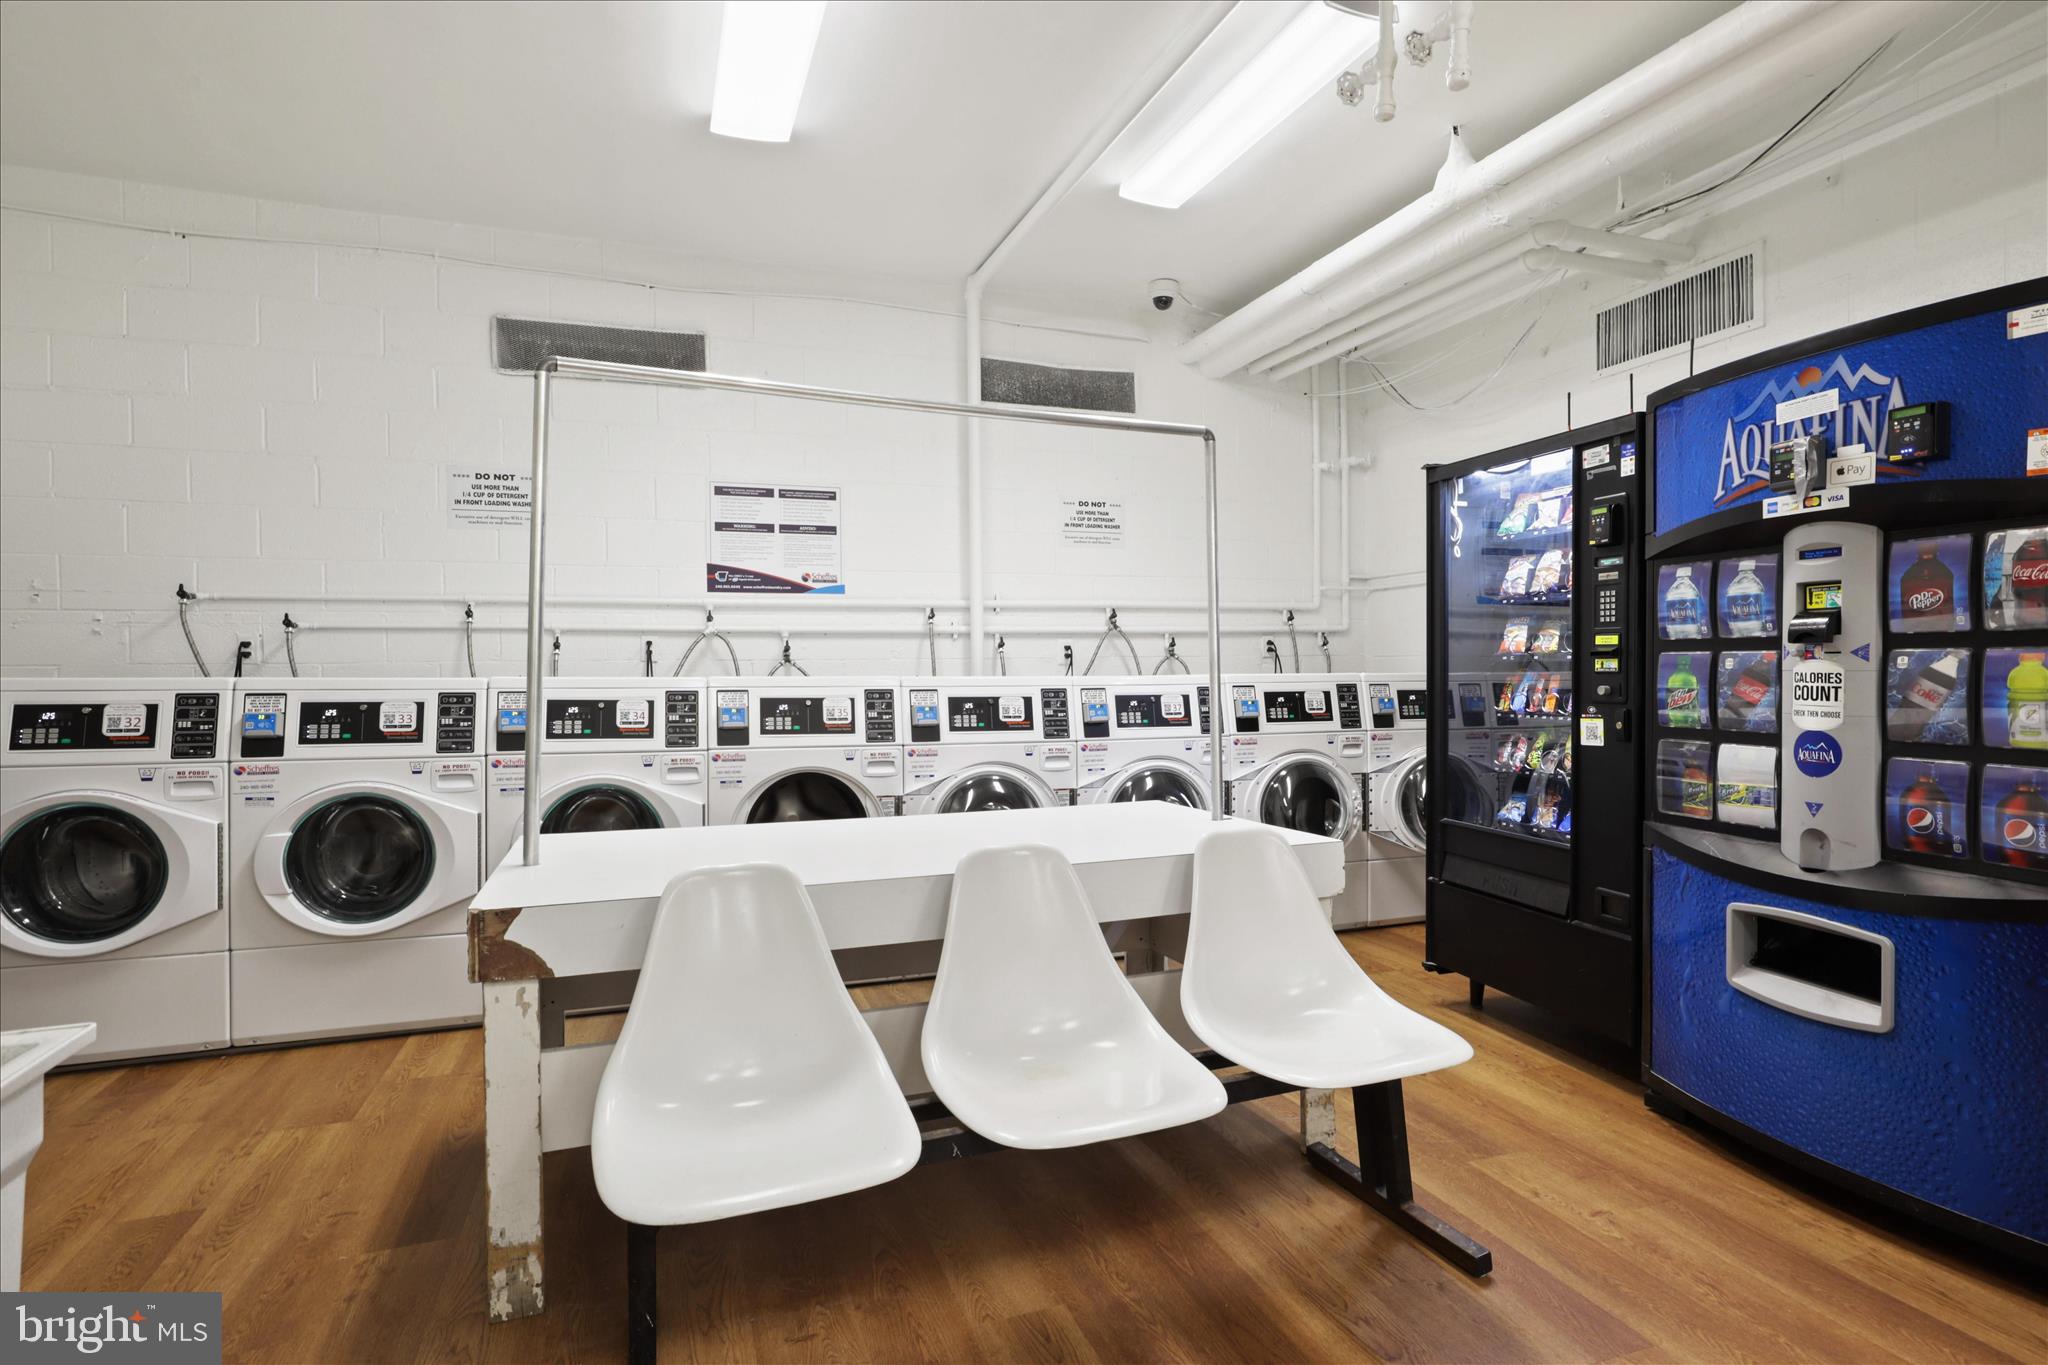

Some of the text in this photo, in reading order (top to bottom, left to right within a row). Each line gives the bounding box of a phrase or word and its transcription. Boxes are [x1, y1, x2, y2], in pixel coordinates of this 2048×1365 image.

[1847, 464, 1866, 475] Pay
[1921, 590, 1933, 600] Dr
[1912, 594, 1942, 610] Pepper
[1794, 672, 1842, 685] CALORIES
[1794, 684, 1842, 702] COUNT
[837, 708, 848, 716] 35
[1012, 706, 1022, 714] 36
[1820, 710, 1841, 719] CHOOSE
[398, 714, 413, 724] 33
[632, 712, 645, 720] 34
[124, 717, 141, 728] 32
[1798, 746, 1835, 764] AQUAFINA
